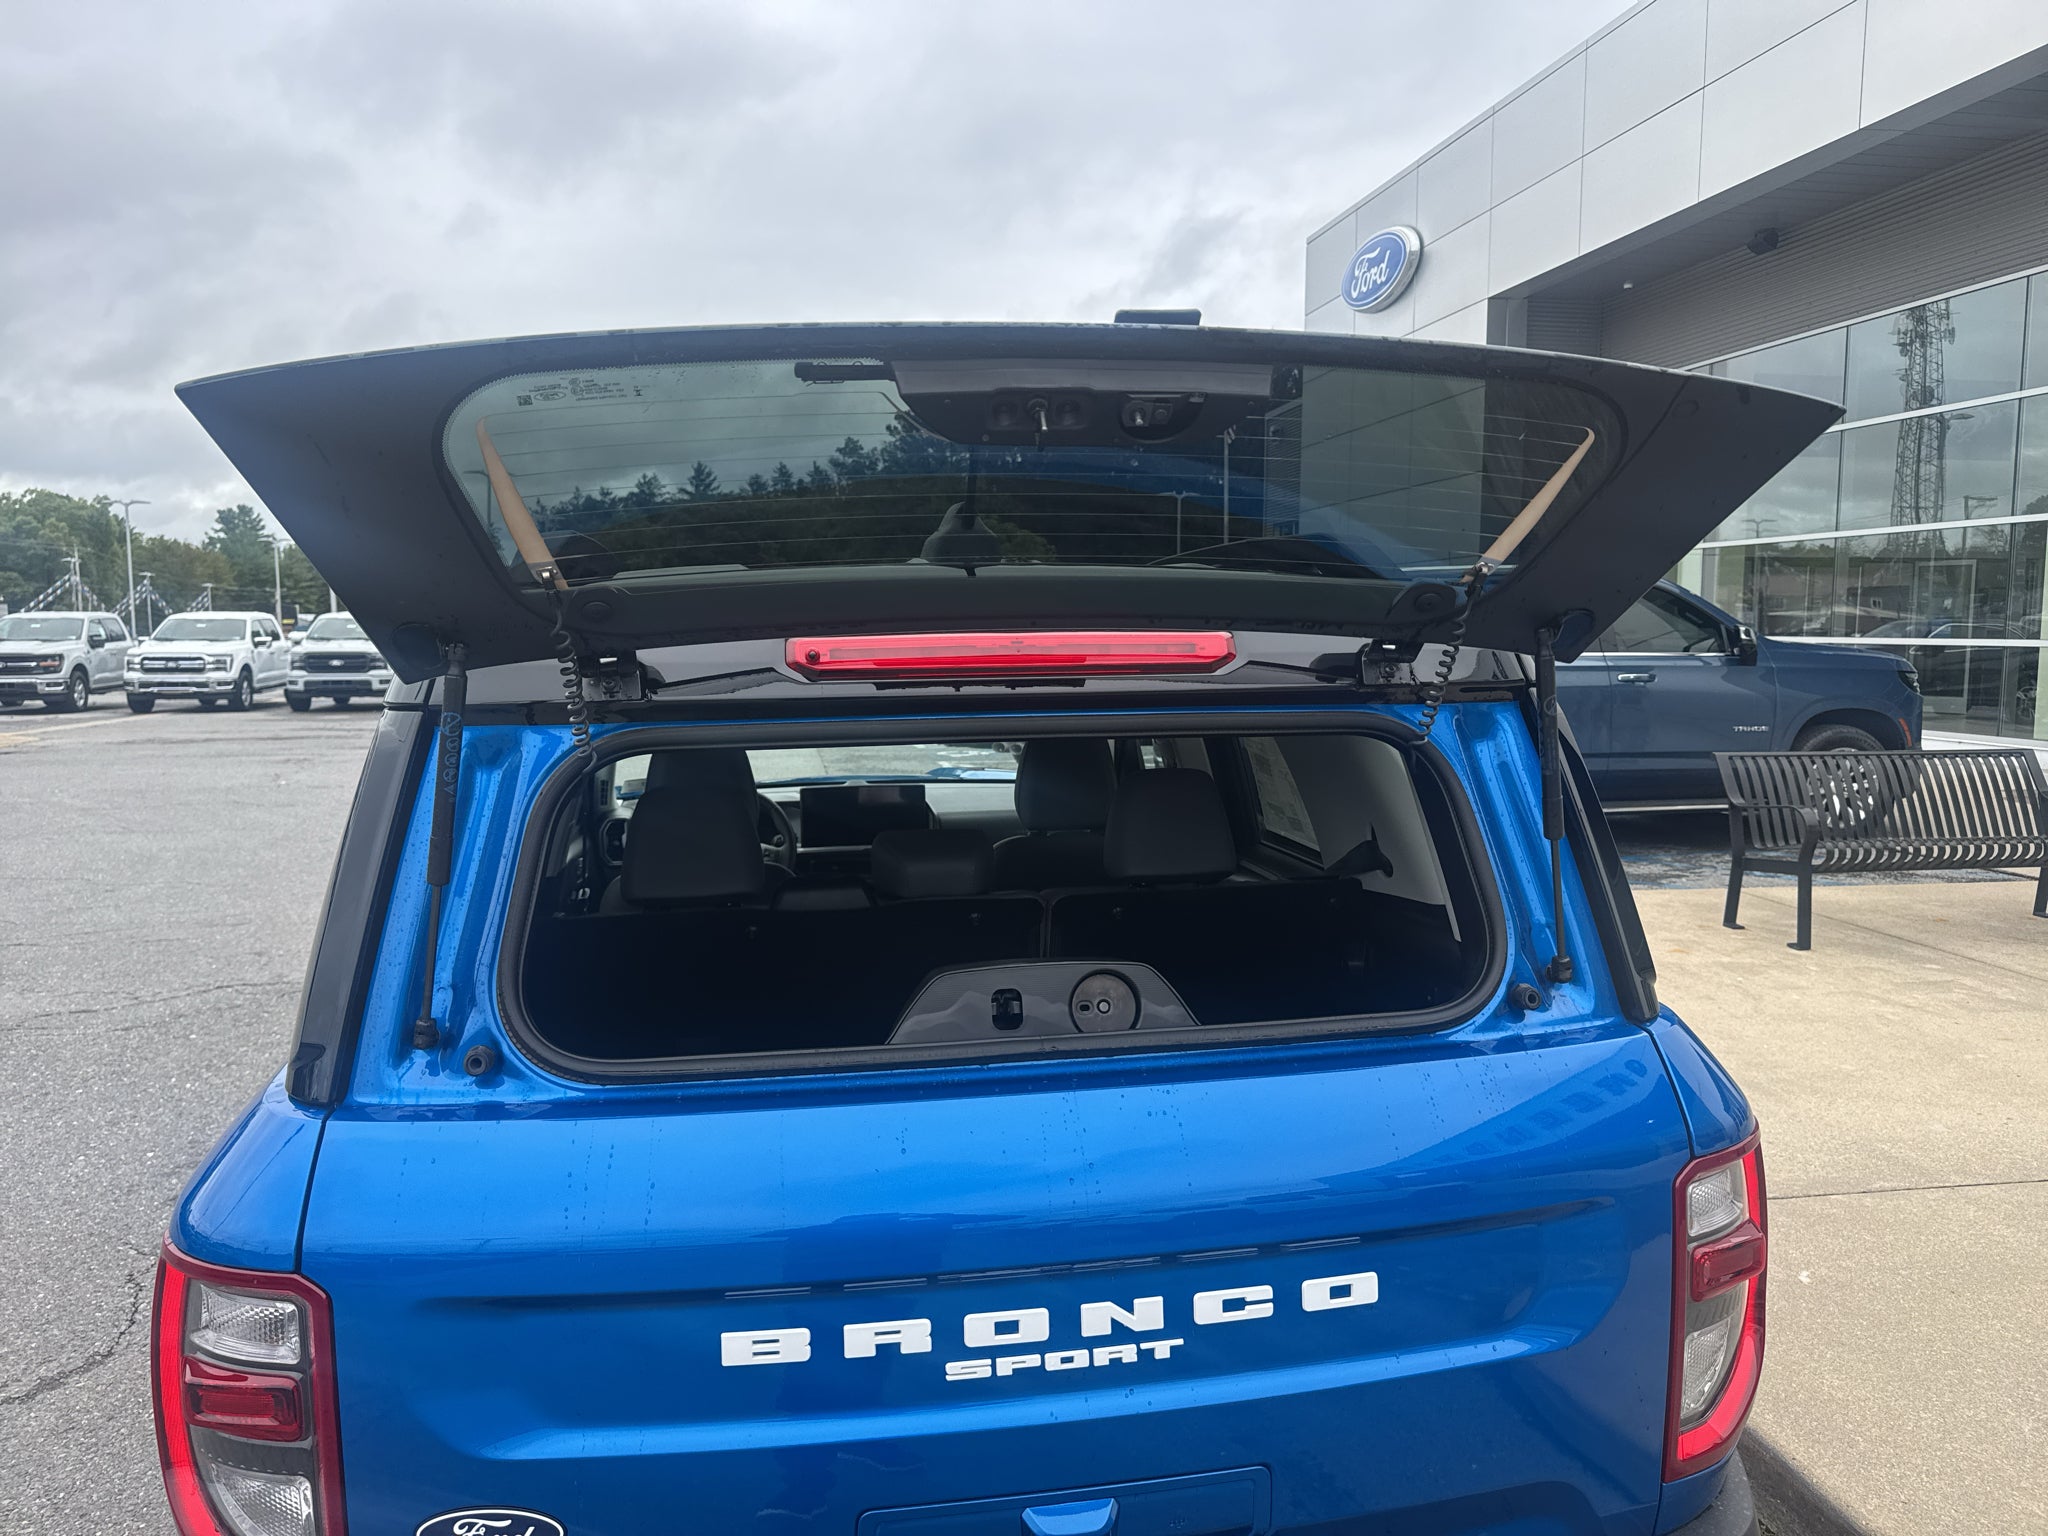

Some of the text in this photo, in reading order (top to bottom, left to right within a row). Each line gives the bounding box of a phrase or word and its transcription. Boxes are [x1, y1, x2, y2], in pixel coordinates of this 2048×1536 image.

[1351, 247, 1391, 299] Ford
[1732, 725, 1769, 733] TAHOE
[720, 1271, 1379, 1367] BRONCO
[944, 1338, 1185, 1382] SPORT
